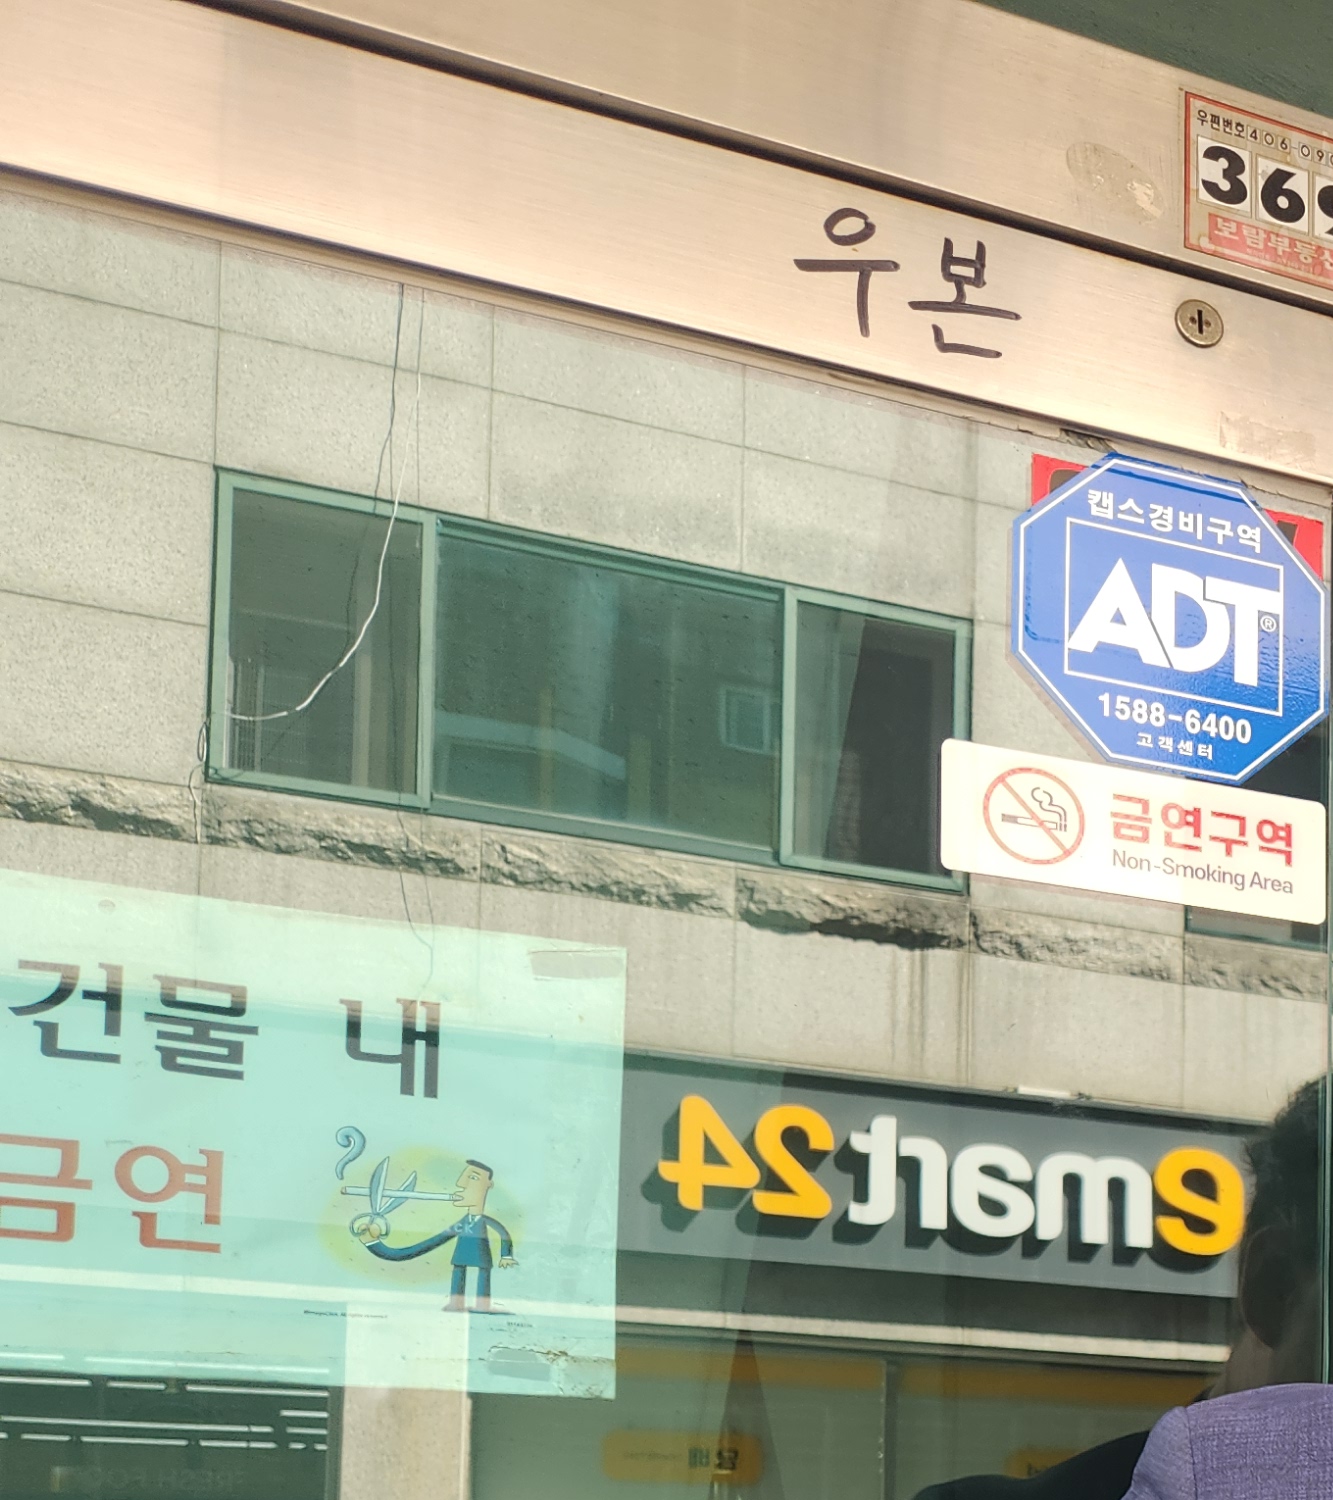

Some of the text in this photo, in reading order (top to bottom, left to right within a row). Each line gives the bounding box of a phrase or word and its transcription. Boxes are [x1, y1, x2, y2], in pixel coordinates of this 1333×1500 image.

[1196, 109, 1246, 139] 우편번호
[793, 207, 1021, 359] 우본
[1087, 488, 1262, 554] 캡스경비구역
[1068, 557, 1280, 687] ADT
[1098, 692, 1252, 744] 1588-6400
[1136, 732, 1214, 761] 고객센터
[1110, 793, 1293, 867] 금연구역
[1112, 848, 1294, 895] Non-Smoking Area
[7, 959, 441, 1100] 건물 내
[0, 1133, 225, 1254] 금연
